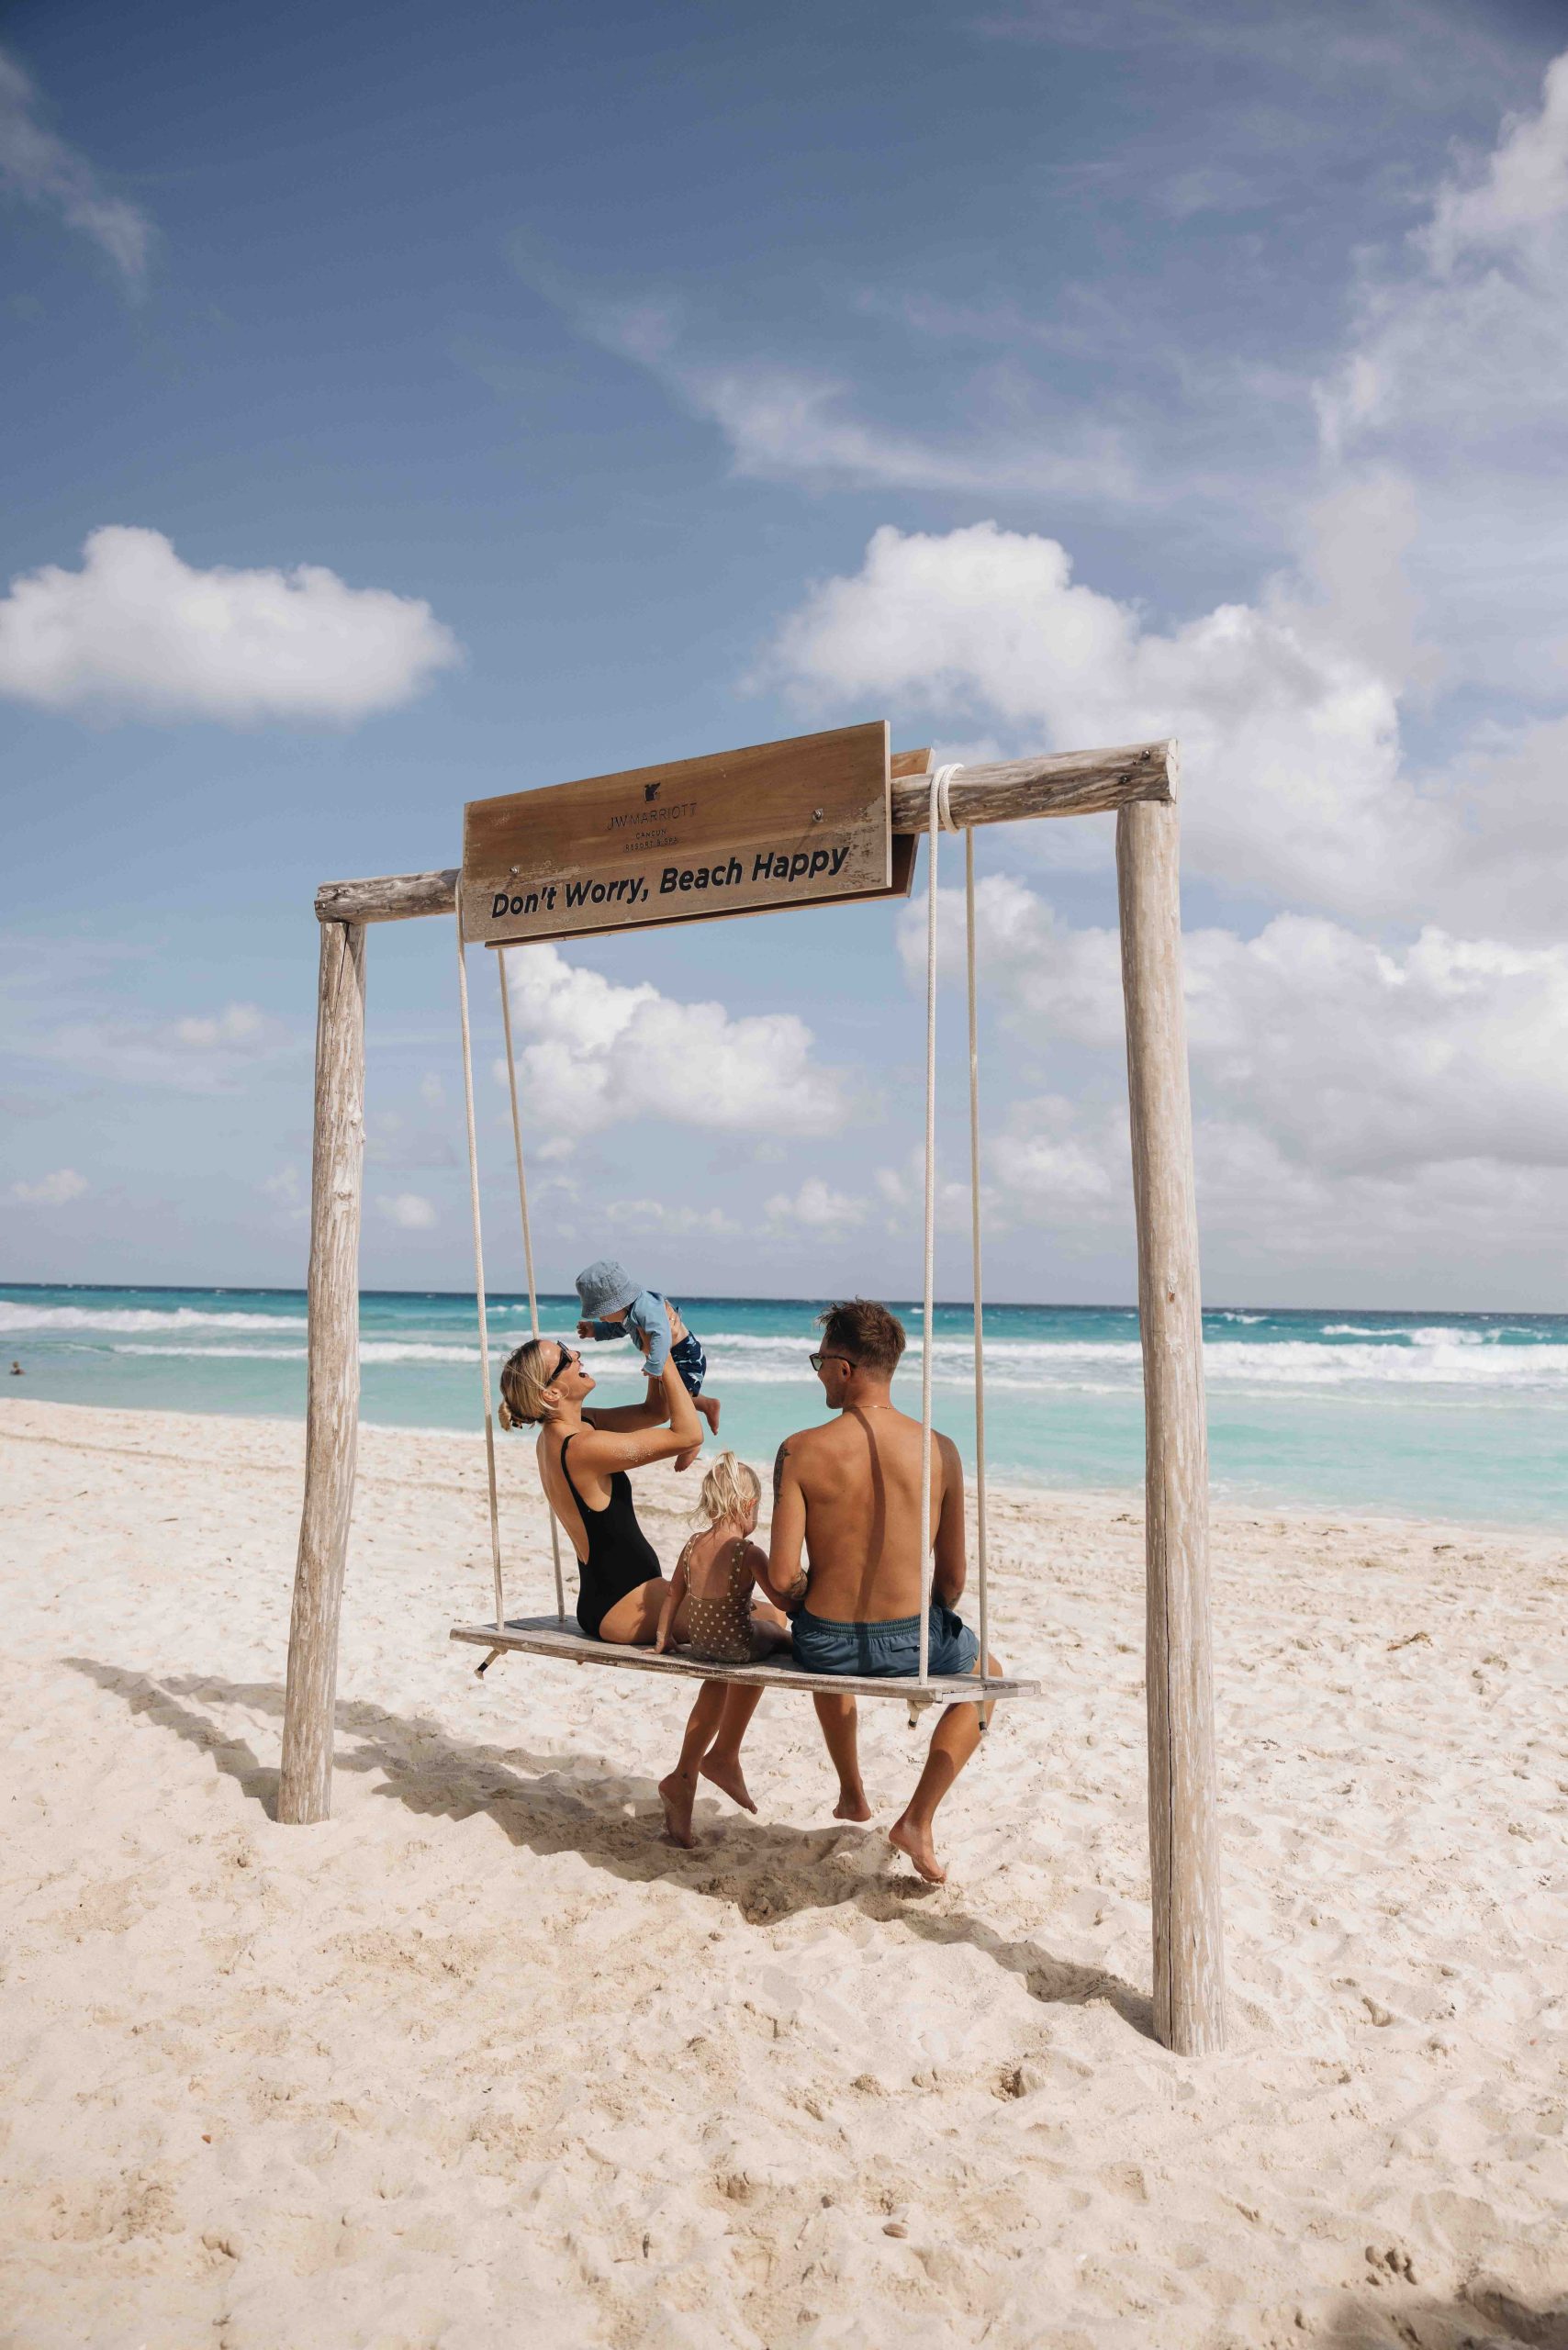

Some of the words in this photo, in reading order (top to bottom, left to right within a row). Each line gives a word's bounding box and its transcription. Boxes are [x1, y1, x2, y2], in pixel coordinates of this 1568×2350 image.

[491, 886, 557, 919] Don't
[564, 875, 649, 907] Worry,
[659, 857, 743, 894] Beach
[751, 846, 850, 883] Happy
